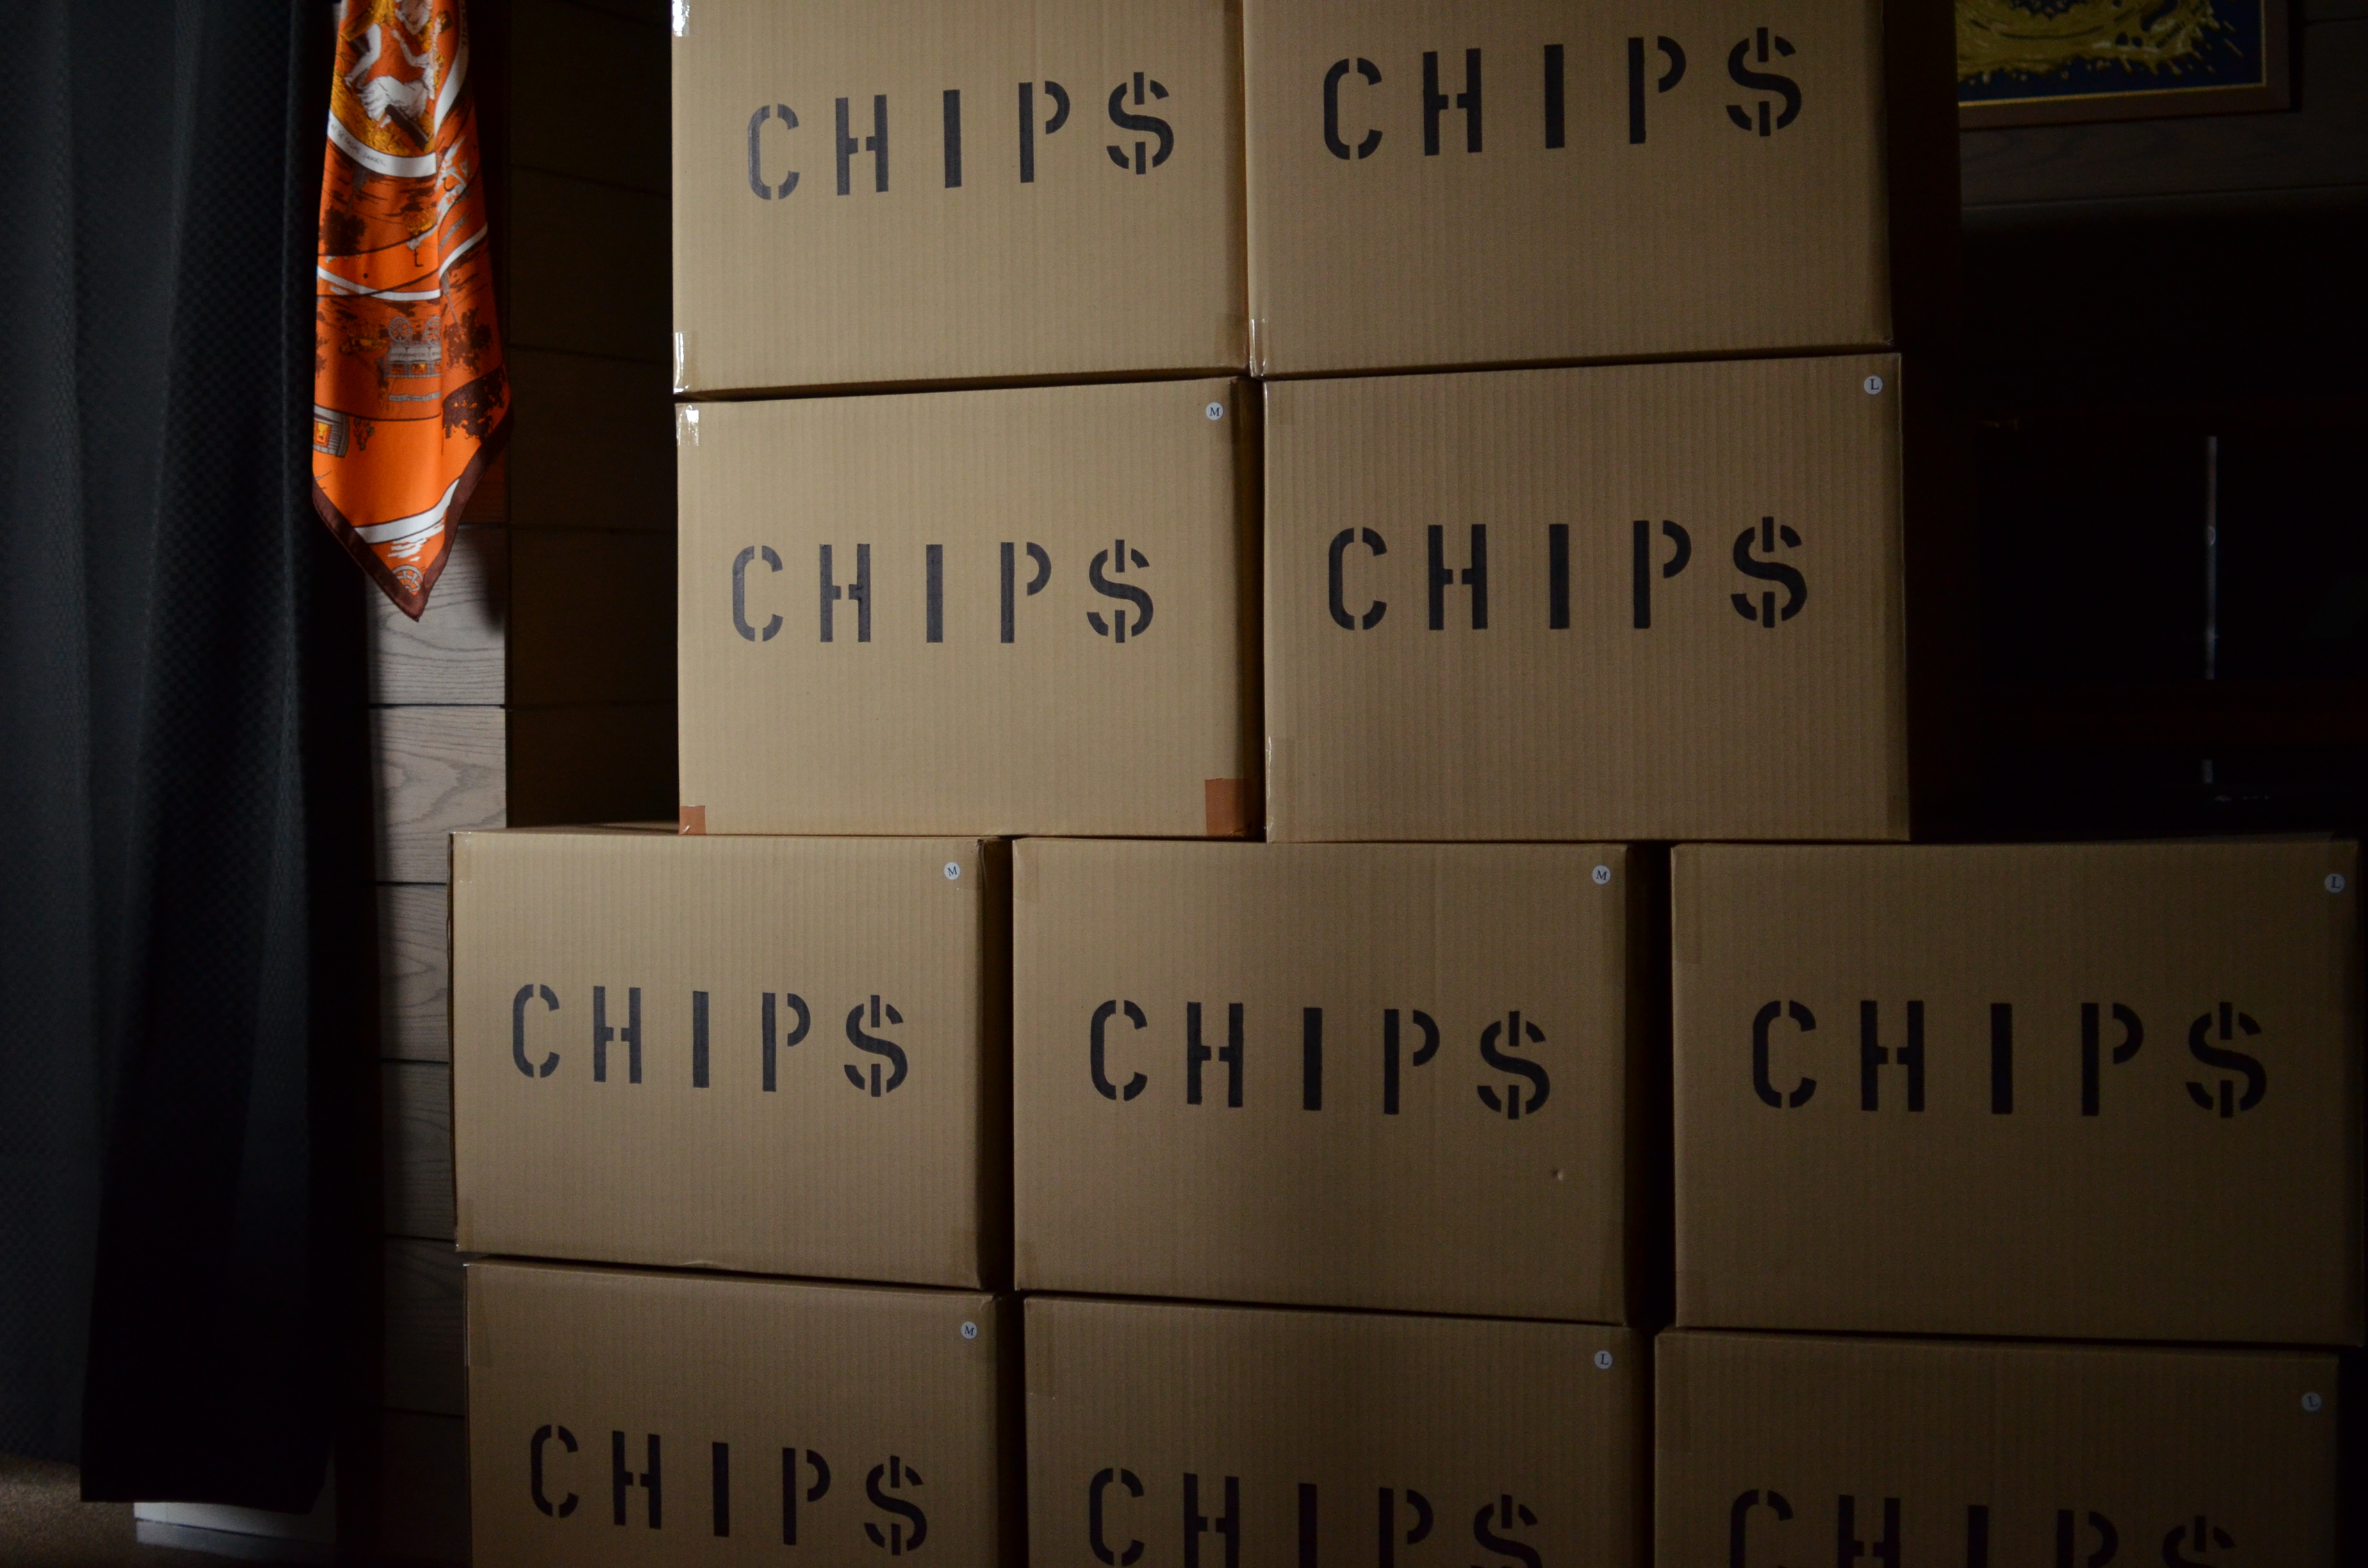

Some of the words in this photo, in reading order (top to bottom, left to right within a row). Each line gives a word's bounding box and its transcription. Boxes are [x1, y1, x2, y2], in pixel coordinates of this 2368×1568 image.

[1870, 379, 1879, 390] L
[1210, 407, 1220, 416] M
[948, 866, 958, 876] M
[1597, 870, 1607, 881] M
[2331, 876, 2340, 888] L
[964, 1325, 974, 1336] M
[1600, 1353, 1609, 1365] L
[2308, 1396, 2318, 1408] L
